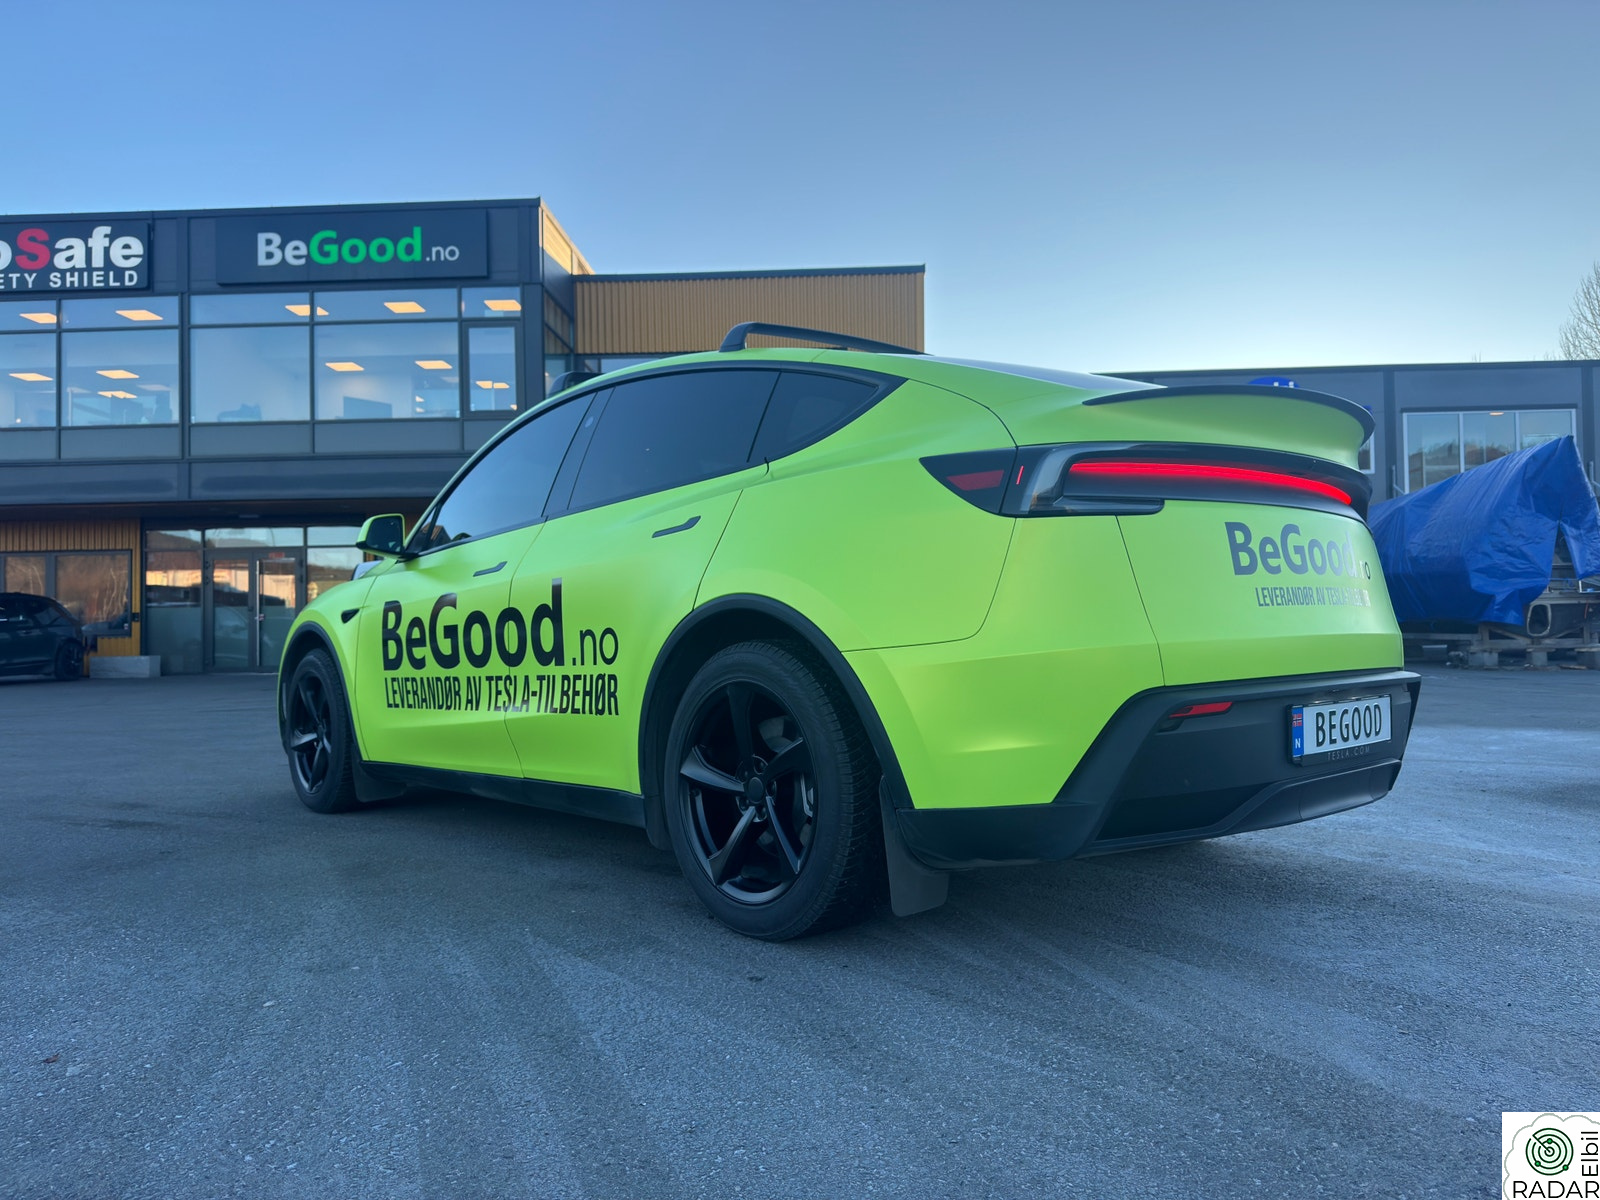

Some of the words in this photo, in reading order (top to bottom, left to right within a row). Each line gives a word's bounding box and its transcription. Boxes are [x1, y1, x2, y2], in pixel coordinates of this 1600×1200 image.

[257, 226, 460, 266] BeGood.no
[49, 270, 138, 288] SHIELD
[382, 577, 619, 671] BeGood.no
[384, 676, 461, 711] LEVERANDØR
[465, 676, 482, 711] AV
[485, 672, 619, 716] TESLA-TILBEHØR
[1295, 738, 1301, 749] N
[1315, 703, 1381, 747] BEGOOD
